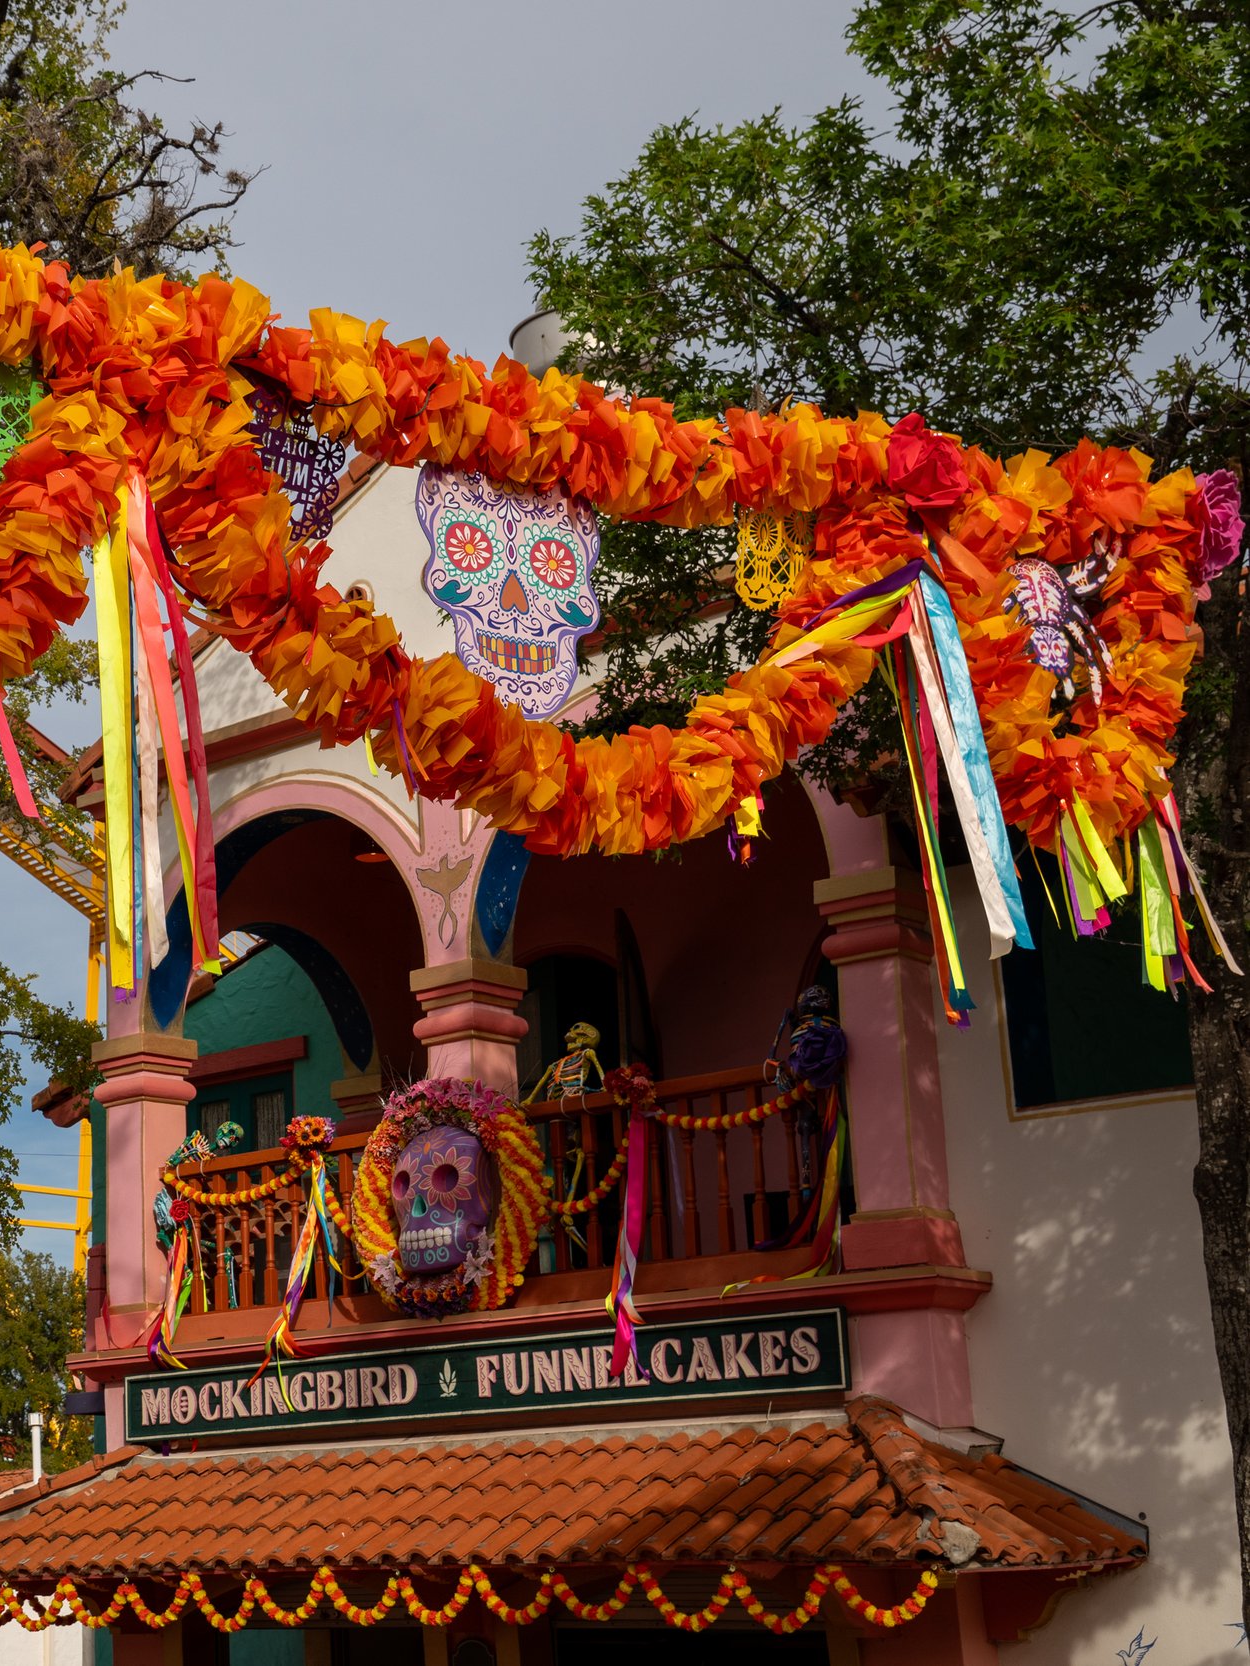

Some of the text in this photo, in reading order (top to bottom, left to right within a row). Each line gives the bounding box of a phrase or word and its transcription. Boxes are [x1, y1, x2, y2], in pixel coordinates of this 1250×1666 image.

[141, 1326, 822, 1427] MOCKINGBIRD FUNNEL CAKES
